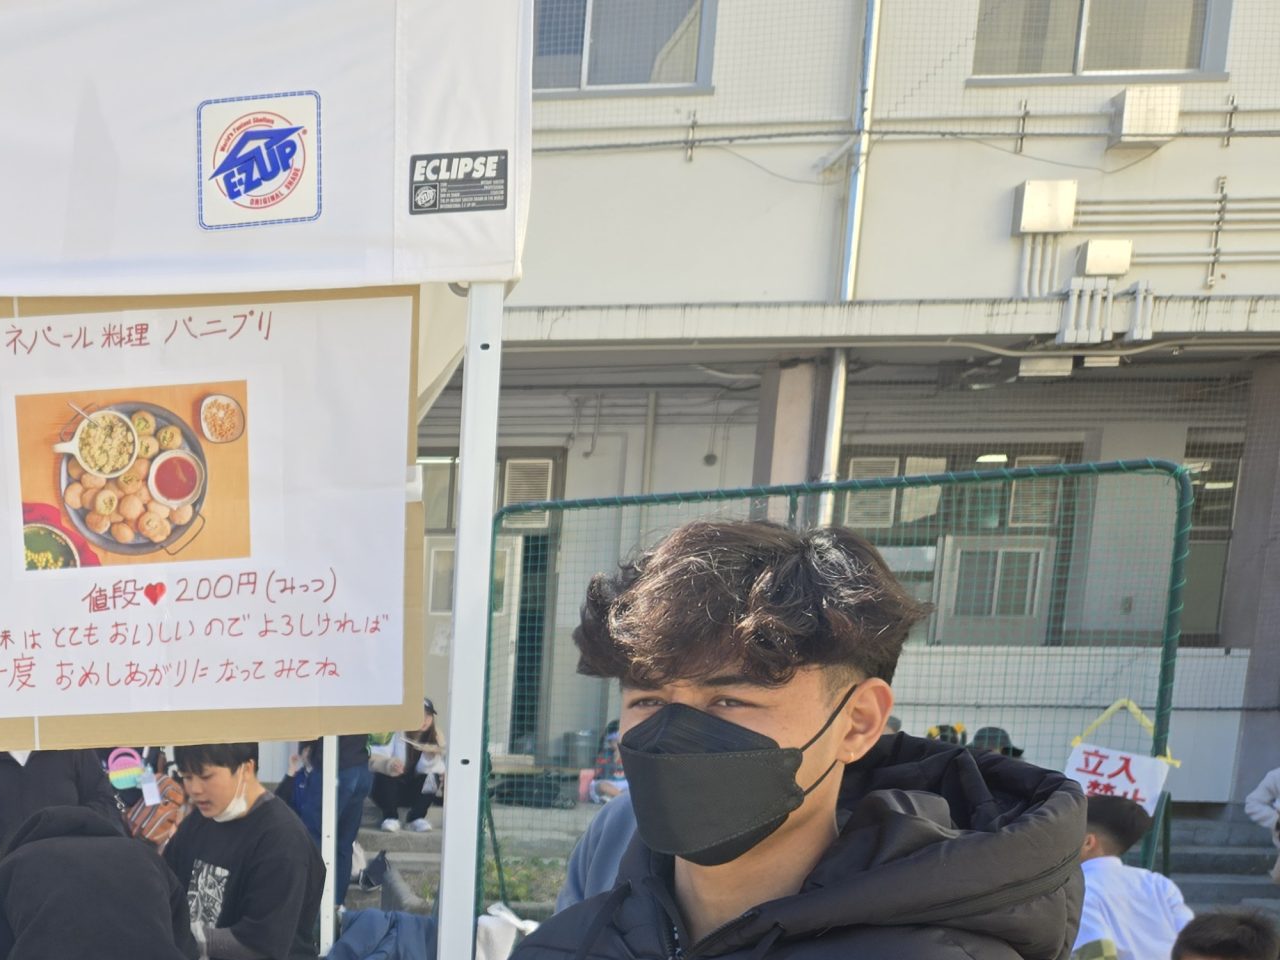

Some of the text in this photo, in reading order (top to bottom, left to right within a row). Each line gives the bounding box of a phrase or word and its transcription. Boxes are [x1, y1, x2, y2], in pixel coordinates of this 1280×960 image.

[413, 155, 499, 182] ECLIPSE
[164, 310, 274, 346] パニプリ
[82, 582, 142, 614] 値段
[1075, 748, 1137, 785] 立入
